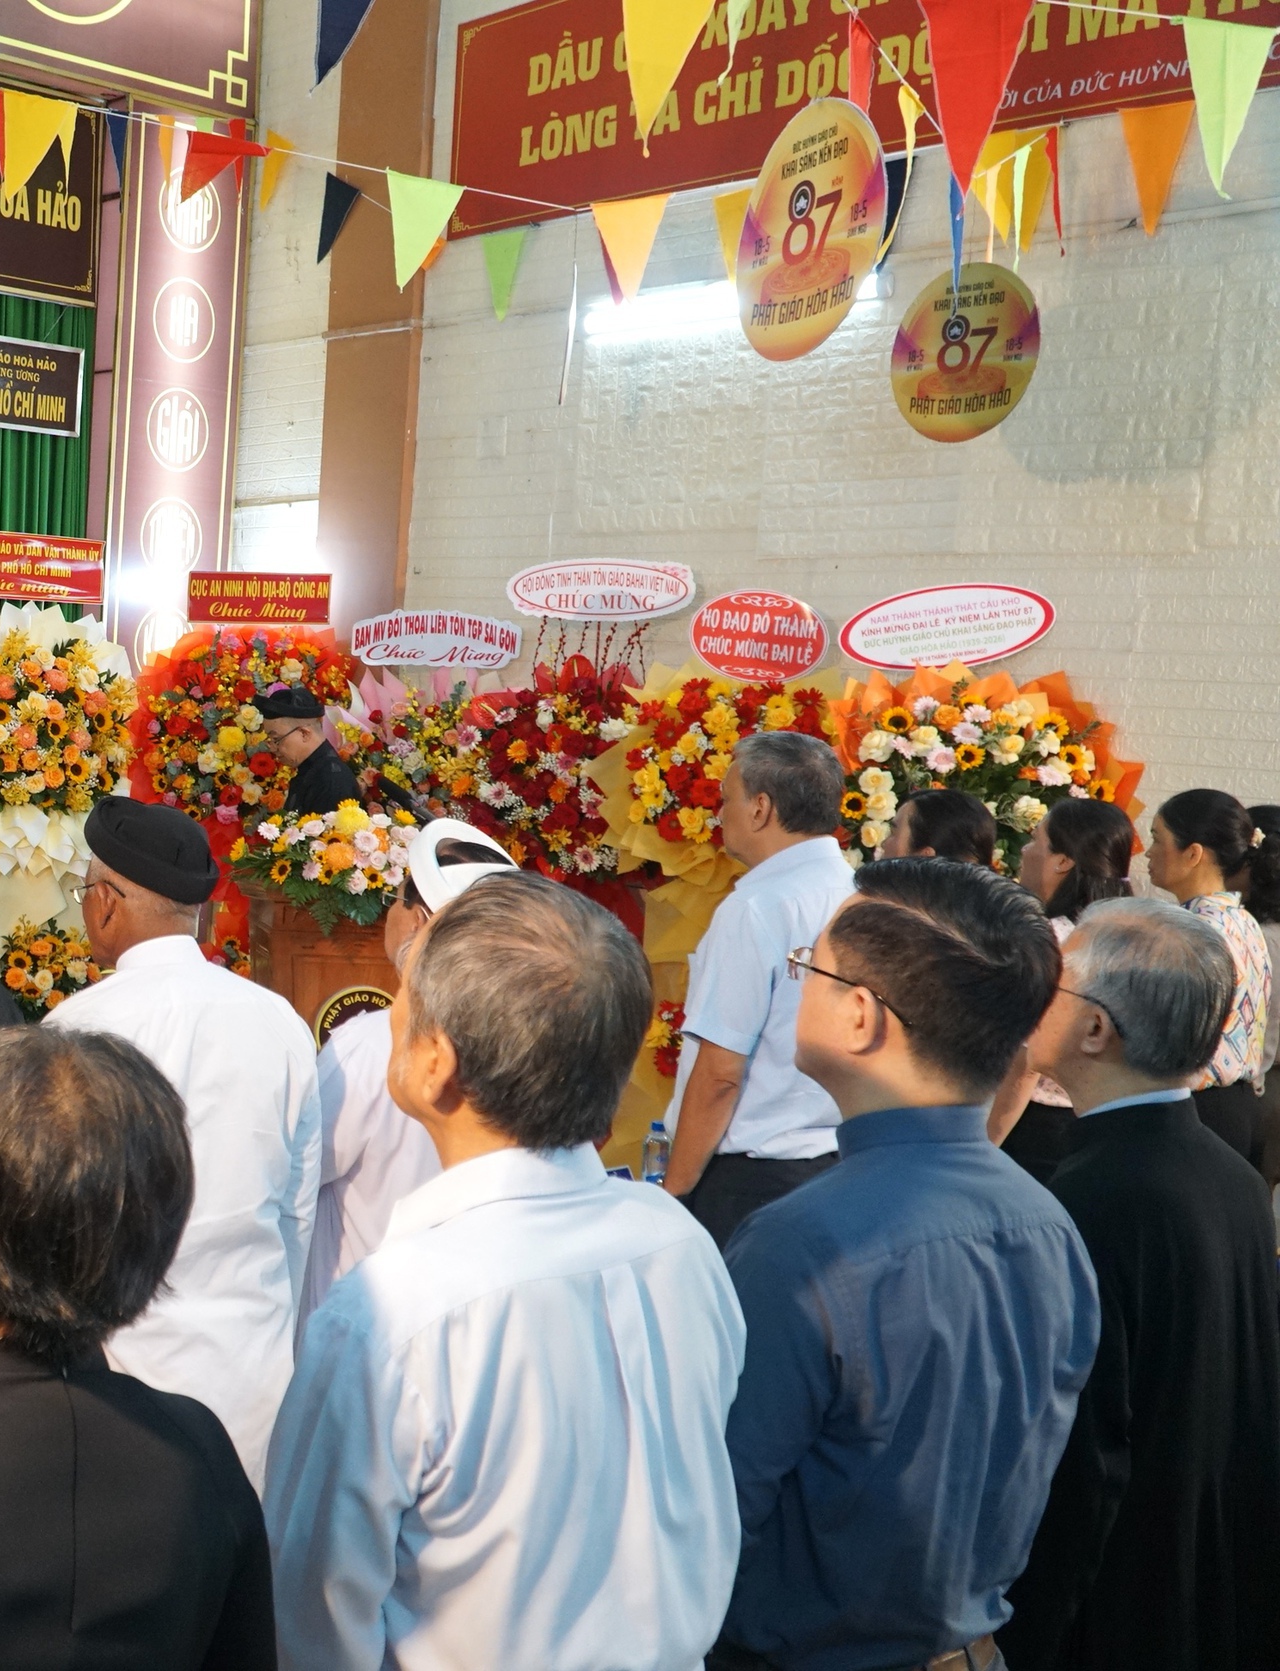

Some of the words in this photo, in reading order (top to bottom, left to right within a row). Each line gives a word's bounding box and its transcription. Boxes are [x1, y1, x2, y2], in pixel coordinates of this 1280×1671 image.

[528, 30, 604, 97] DẦU
[1023, 76, 1063, 106] CỦA
[1069, 70, 1114, 97] ĐỨC
[519, 105, 618, 167] LÒNG
[693, 55, 765, 126] CHỈ
[781, 159, 798, 180] KHAI
[799, 150, 817, 173] SÁNG
[833, 137, 849, 160] ĐẠO
[37, 180, 81, 232] HẢO
[850, 199, 868, 223] 18-5
[782, 180, 843, 266] 87
[754, 235, 771, 256] 18-5
[751, 299, 778, 331] PHẬT
[778, 295, 803, 325] GIÁO
[805, 288, 828, 318] HÒA
[830, 273, 854, 309] HẢO
[934, 300, 951, 312] KHAI
[989, 290, 1005, 306] ĐẠO
[908, 349, 924, 363] 18-5
[937, 315, 998, 376] 87
[1005, 338, 1023, 352] 18-5
[13, 352, 34, 368] HOÀ
[36, 355, 57, 372] HẢO
[16, 369, 40, 383] ƯƠNG
[14, 386, 36, 417] CHÍ
[36, 395, 66, 423] MINH
[909, 395, 936, 418] PHẬT
[938, 393, 962, 415] GIÁO
[964, 392, 986, 413] HÒA
[988, 386, 1011, 409] HẢO
[156, 395, 200, 464] GIÁI
[14, 541, 24, 556] VÀ
[26, 543, 42, 557] DÂN
[44, 544, 60, 560] VẬN
[62, 545, 91, 561] THÀNH
[89, 547, 100, 562] ỦY
[1, 559, 19, 574] PHỐ
[20, 560, 32, 575] HỒ
[34, 563, 49, 577] CHÍ
[50, 567, 71, 578] MINH
[522, 578, 535, 597] HỘI
[593, 567, 607, 586] TÔN
[608, 568, 625, 587] GIÁO
[649, 575, 664, 597] VIỆT
[664, 581, 680, 596] NAM
[190, 579, 208, 600] CỤC
[209, 580, 222, 597] AN
[223, 580, 244, 597] NINH
[246, 577, 261, 601] NỘI
[262, 577, 291, 602] ĐỊA-BỘ
[293, 577, 315, 599] CÔNG
[317, 582, 329, 599] AN
[545, 589, 595, 609] CHÚC
[599, 590, 655, 610] MỪNG
[209, 602, 252, 618] Chúc
[255, 602, 307, 621] Mừng
[701, 608, 720, 632] HỌ
[722, 610, 750, 634] ĐẠO
[752, 611, 770, 634] ĐÔ
[773, 614, 819, 640] THÀNH
[861, 627, 882, 637] KÍNH
[883, 622, 911, 635] MỪNG
[912, 621, 928, 632] ĐẠI
[959, 613, 981, 625] NIỆM
[1023, 607, 1033, 615] 87
[870, 615, 889, 625] NAM
[355, 625, 371, 650] BAN
[373, 621, 386, 643] MV
[387, 610, 403, 639] ĐỐI
[405, 615, 428, 639] THOẠI
[430, 611, 447, 634] LIÊN
[450, 612, 466, 636] TÔN
[468, 619, 483, 640] TGP
[484, 619, 497, 646] SÀI
[499, 624, 517, 654] GÒN
[365, 644, 426, 660] Chúc
[429, 646, 505, 667] Mừng
[700, 635, 732, 656] CHÚC
[734, 638, 769, 661] MỪNG
[771, 644, 794, 665] ĐẠI
[797, 642, 813, 665] LỄ
[324, 1003, 342, 1029] PHẬT
[343, 993, 369, 1006] GIÁO
